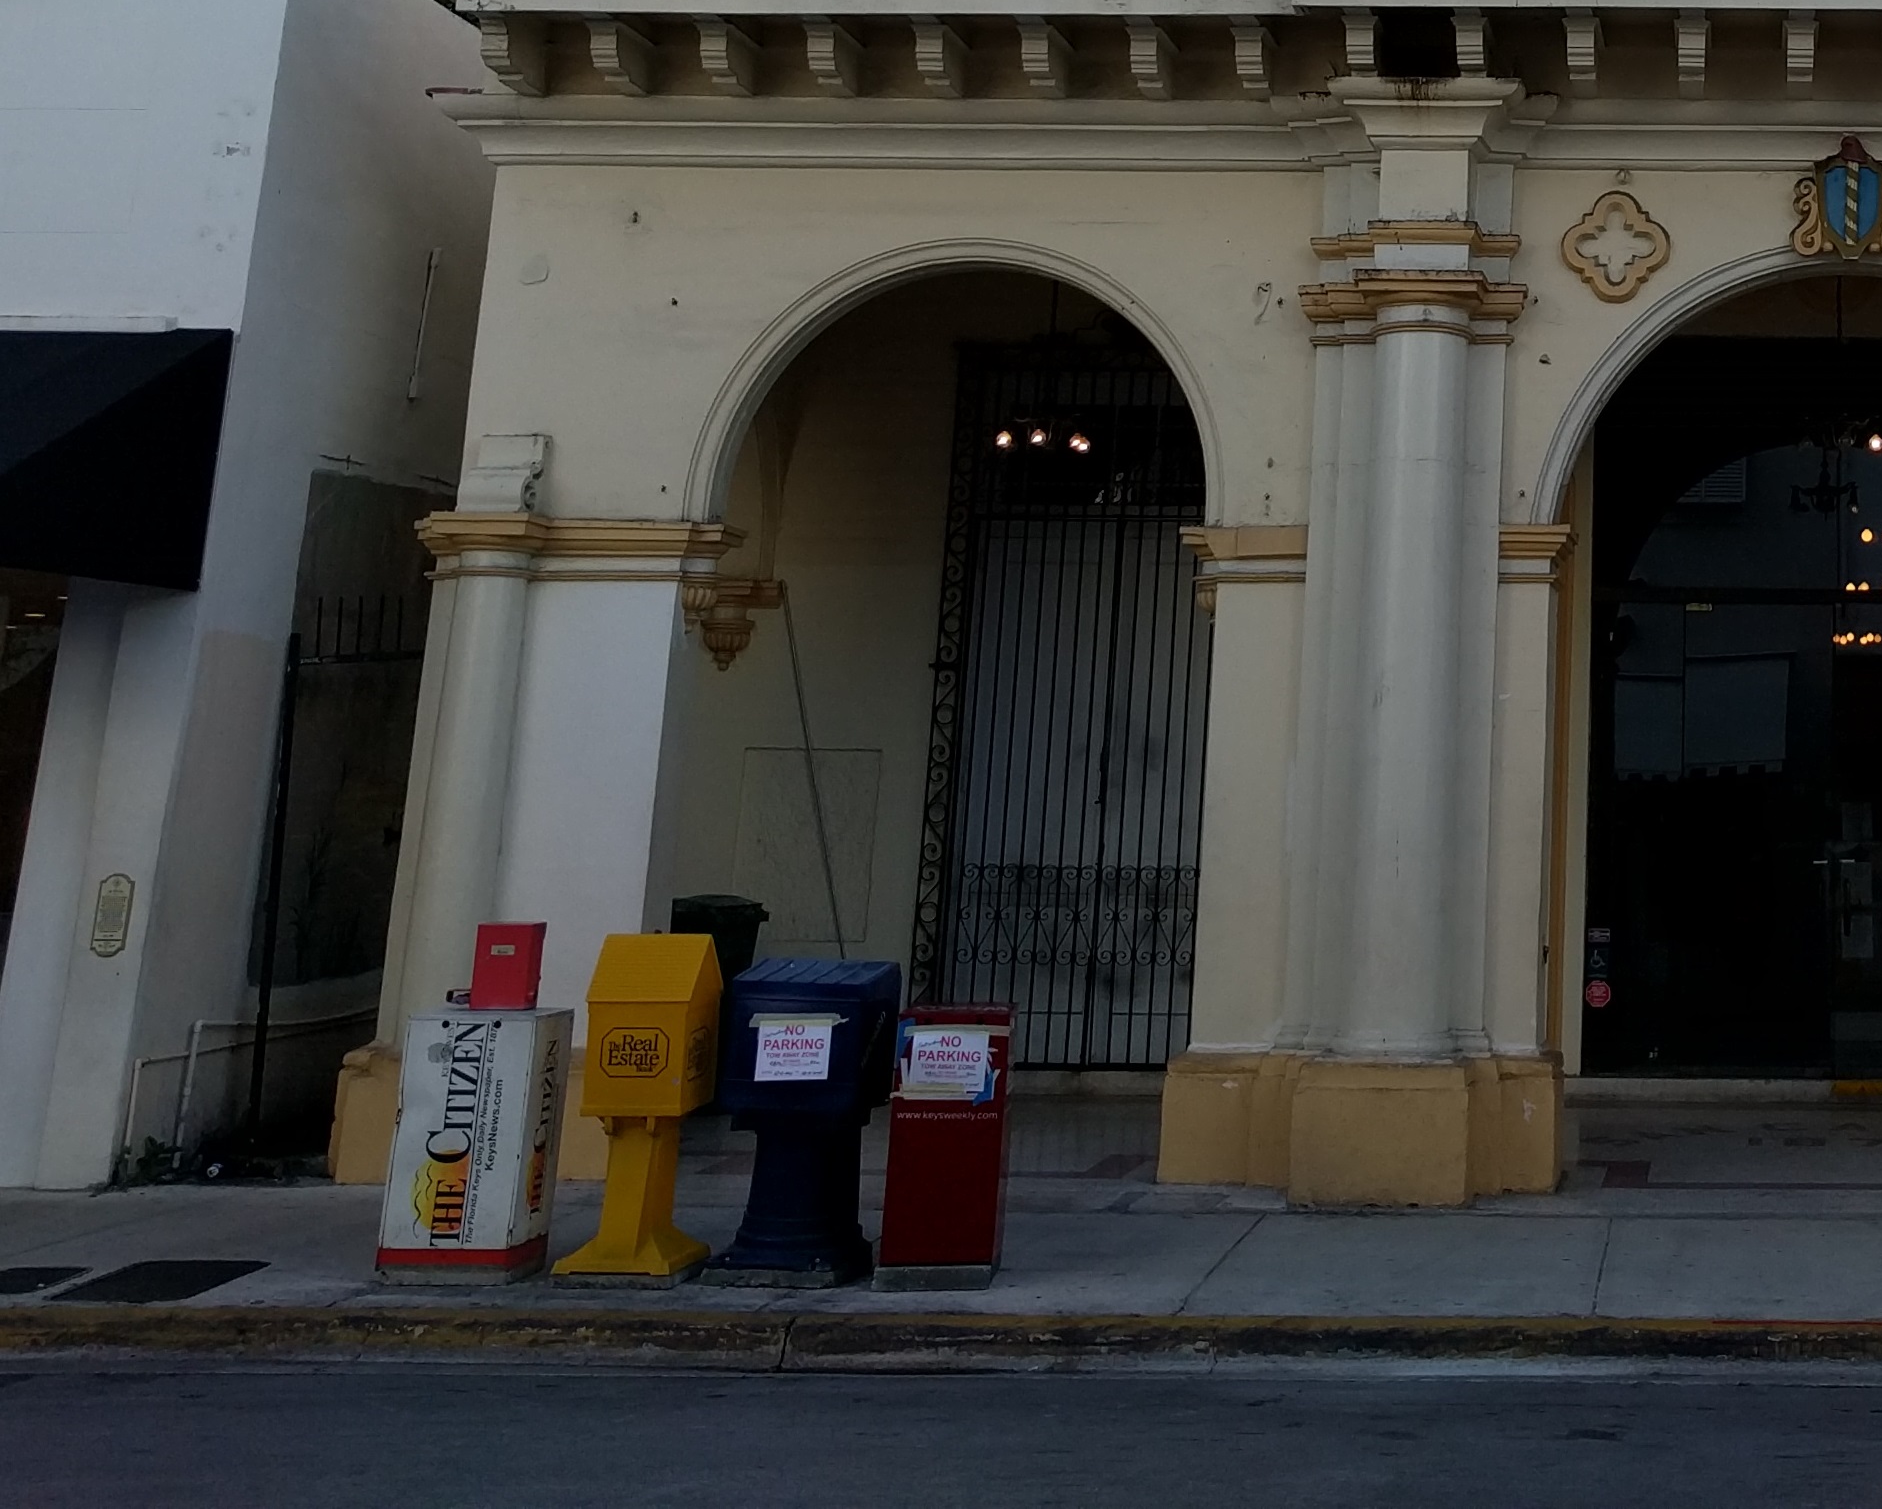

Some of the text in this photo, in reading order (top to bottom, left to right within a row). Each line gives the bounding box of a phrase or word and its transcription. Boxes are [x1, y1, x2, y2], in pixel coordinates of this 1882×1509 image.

[784, 1024, 805, 1036] NO
[621, 1033, 659, 1052] Real
[763, 1038, 825, 1051] PARKING
[940, 1035, 962, 1048] NO
[607, 1050, 660, 1067] Estate
[917, 1050, 982, 1063] PARKING
[896, 1110, 998, 1121] www.keysweekly.com
[425, 1021, 486, 1247] THE CITIZEN
[476, 1120, 488, 1143] Daily
[485, 1079, 503, 1172] KeysNews.com
[474, 1144, 485, 1167] Only
[471, 1169, 482, 1191] Keys
[467, 1193, 478, 1226] Florida
[465, 1228, 474, 1244] The
